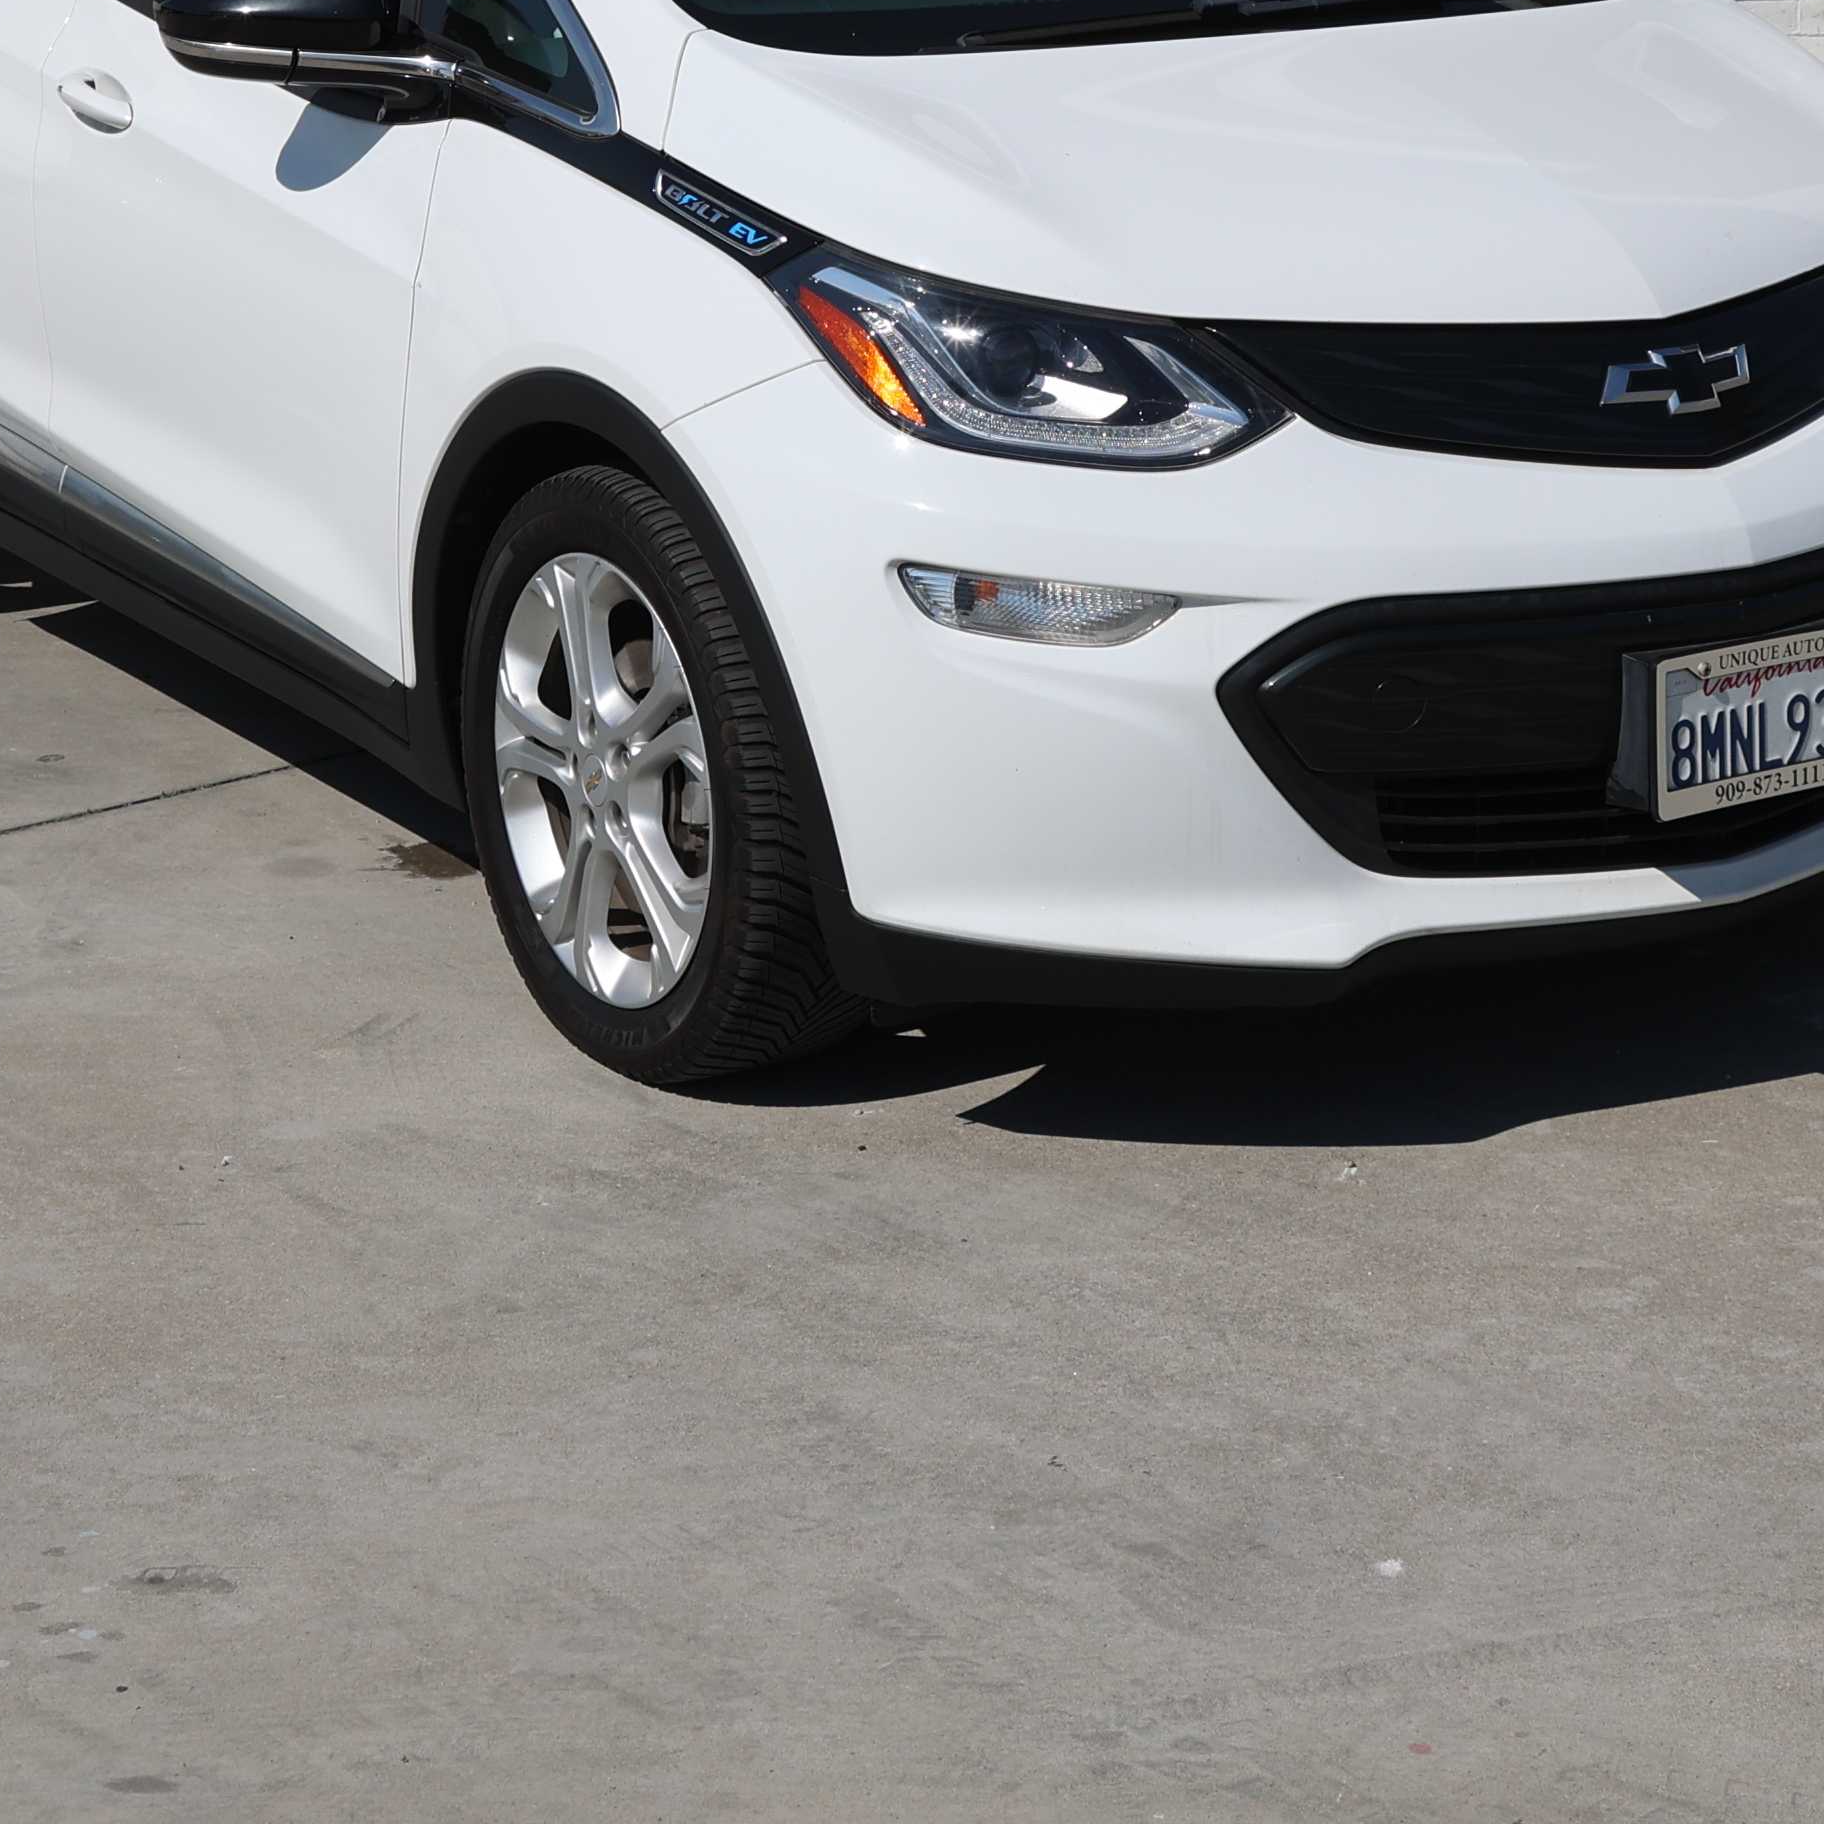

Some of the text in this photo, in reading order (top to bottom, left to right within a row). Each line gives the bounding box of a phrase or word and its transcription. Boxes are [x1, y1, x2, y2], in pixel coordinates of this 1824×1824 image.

[665, 185, 768, 245] BOLT EV
[1719, 646, 1780, 669] UNIQUE
